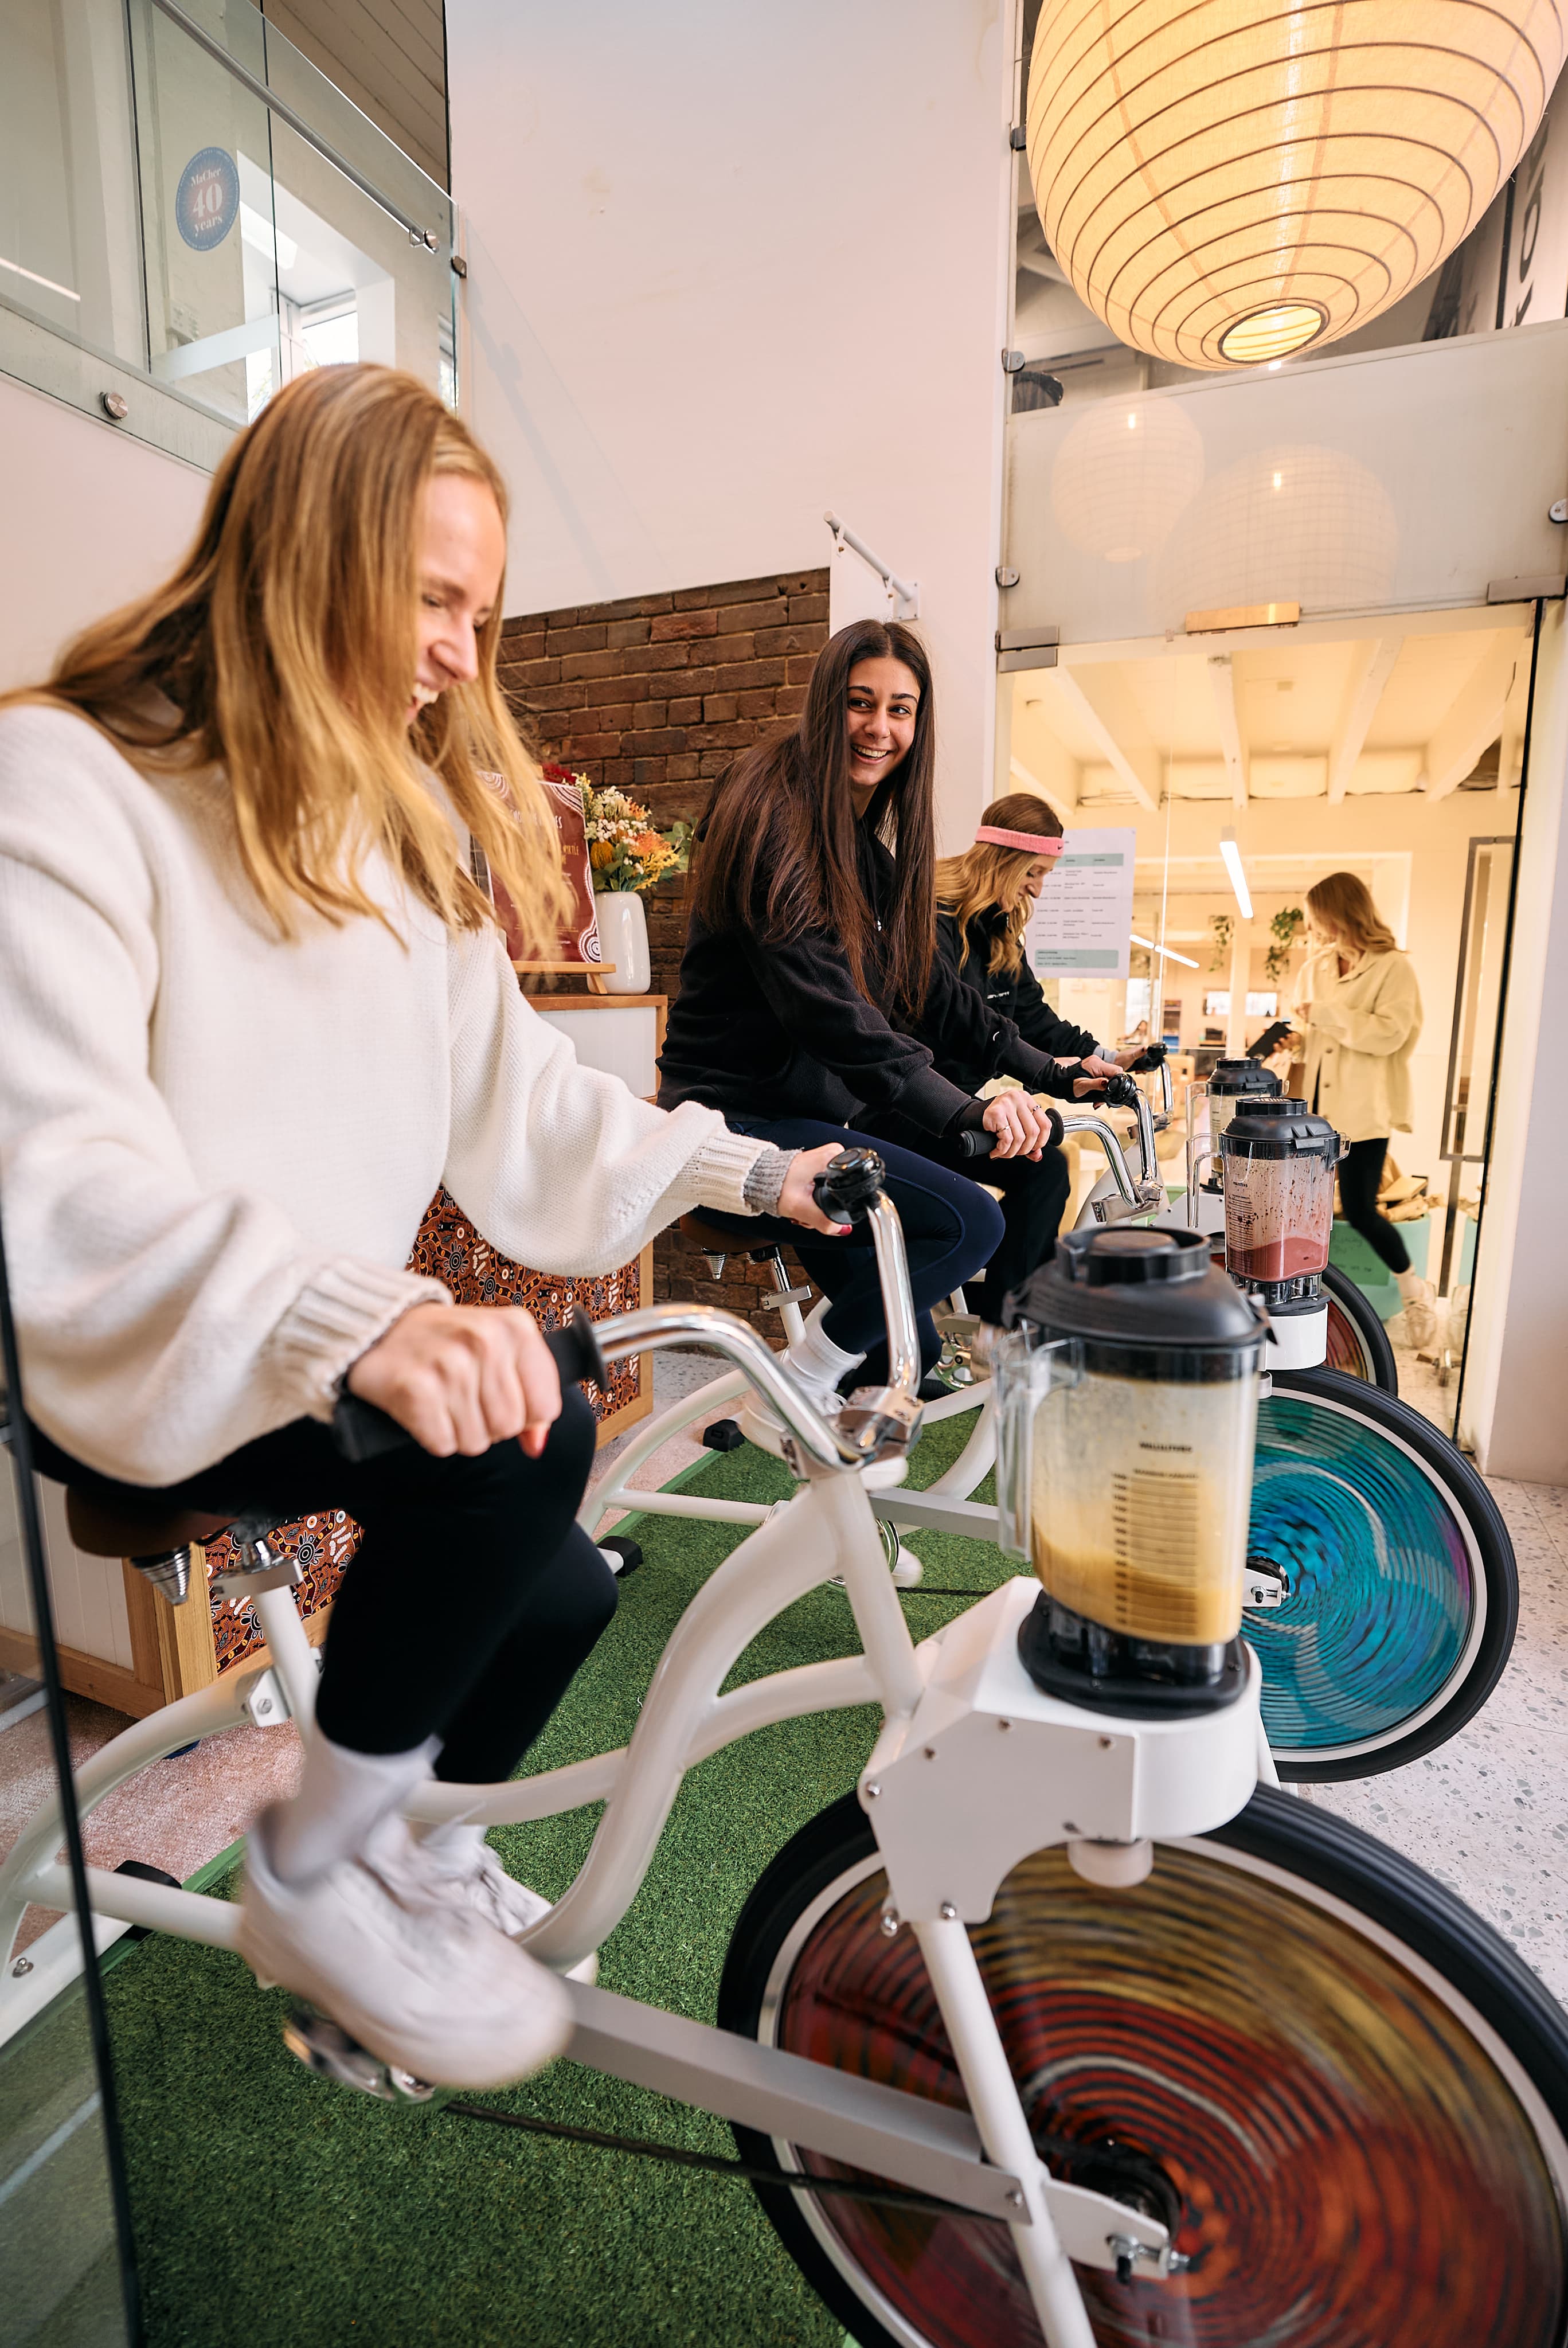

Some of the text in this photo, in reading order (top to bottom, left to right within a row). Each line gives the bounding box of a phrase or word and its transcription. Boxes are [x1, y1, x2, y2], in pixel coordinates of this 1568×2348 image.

[191, 167, 221, 187] MaCher
[193, 183, 223, 218] 40
[194, 216, 223, 237] years
